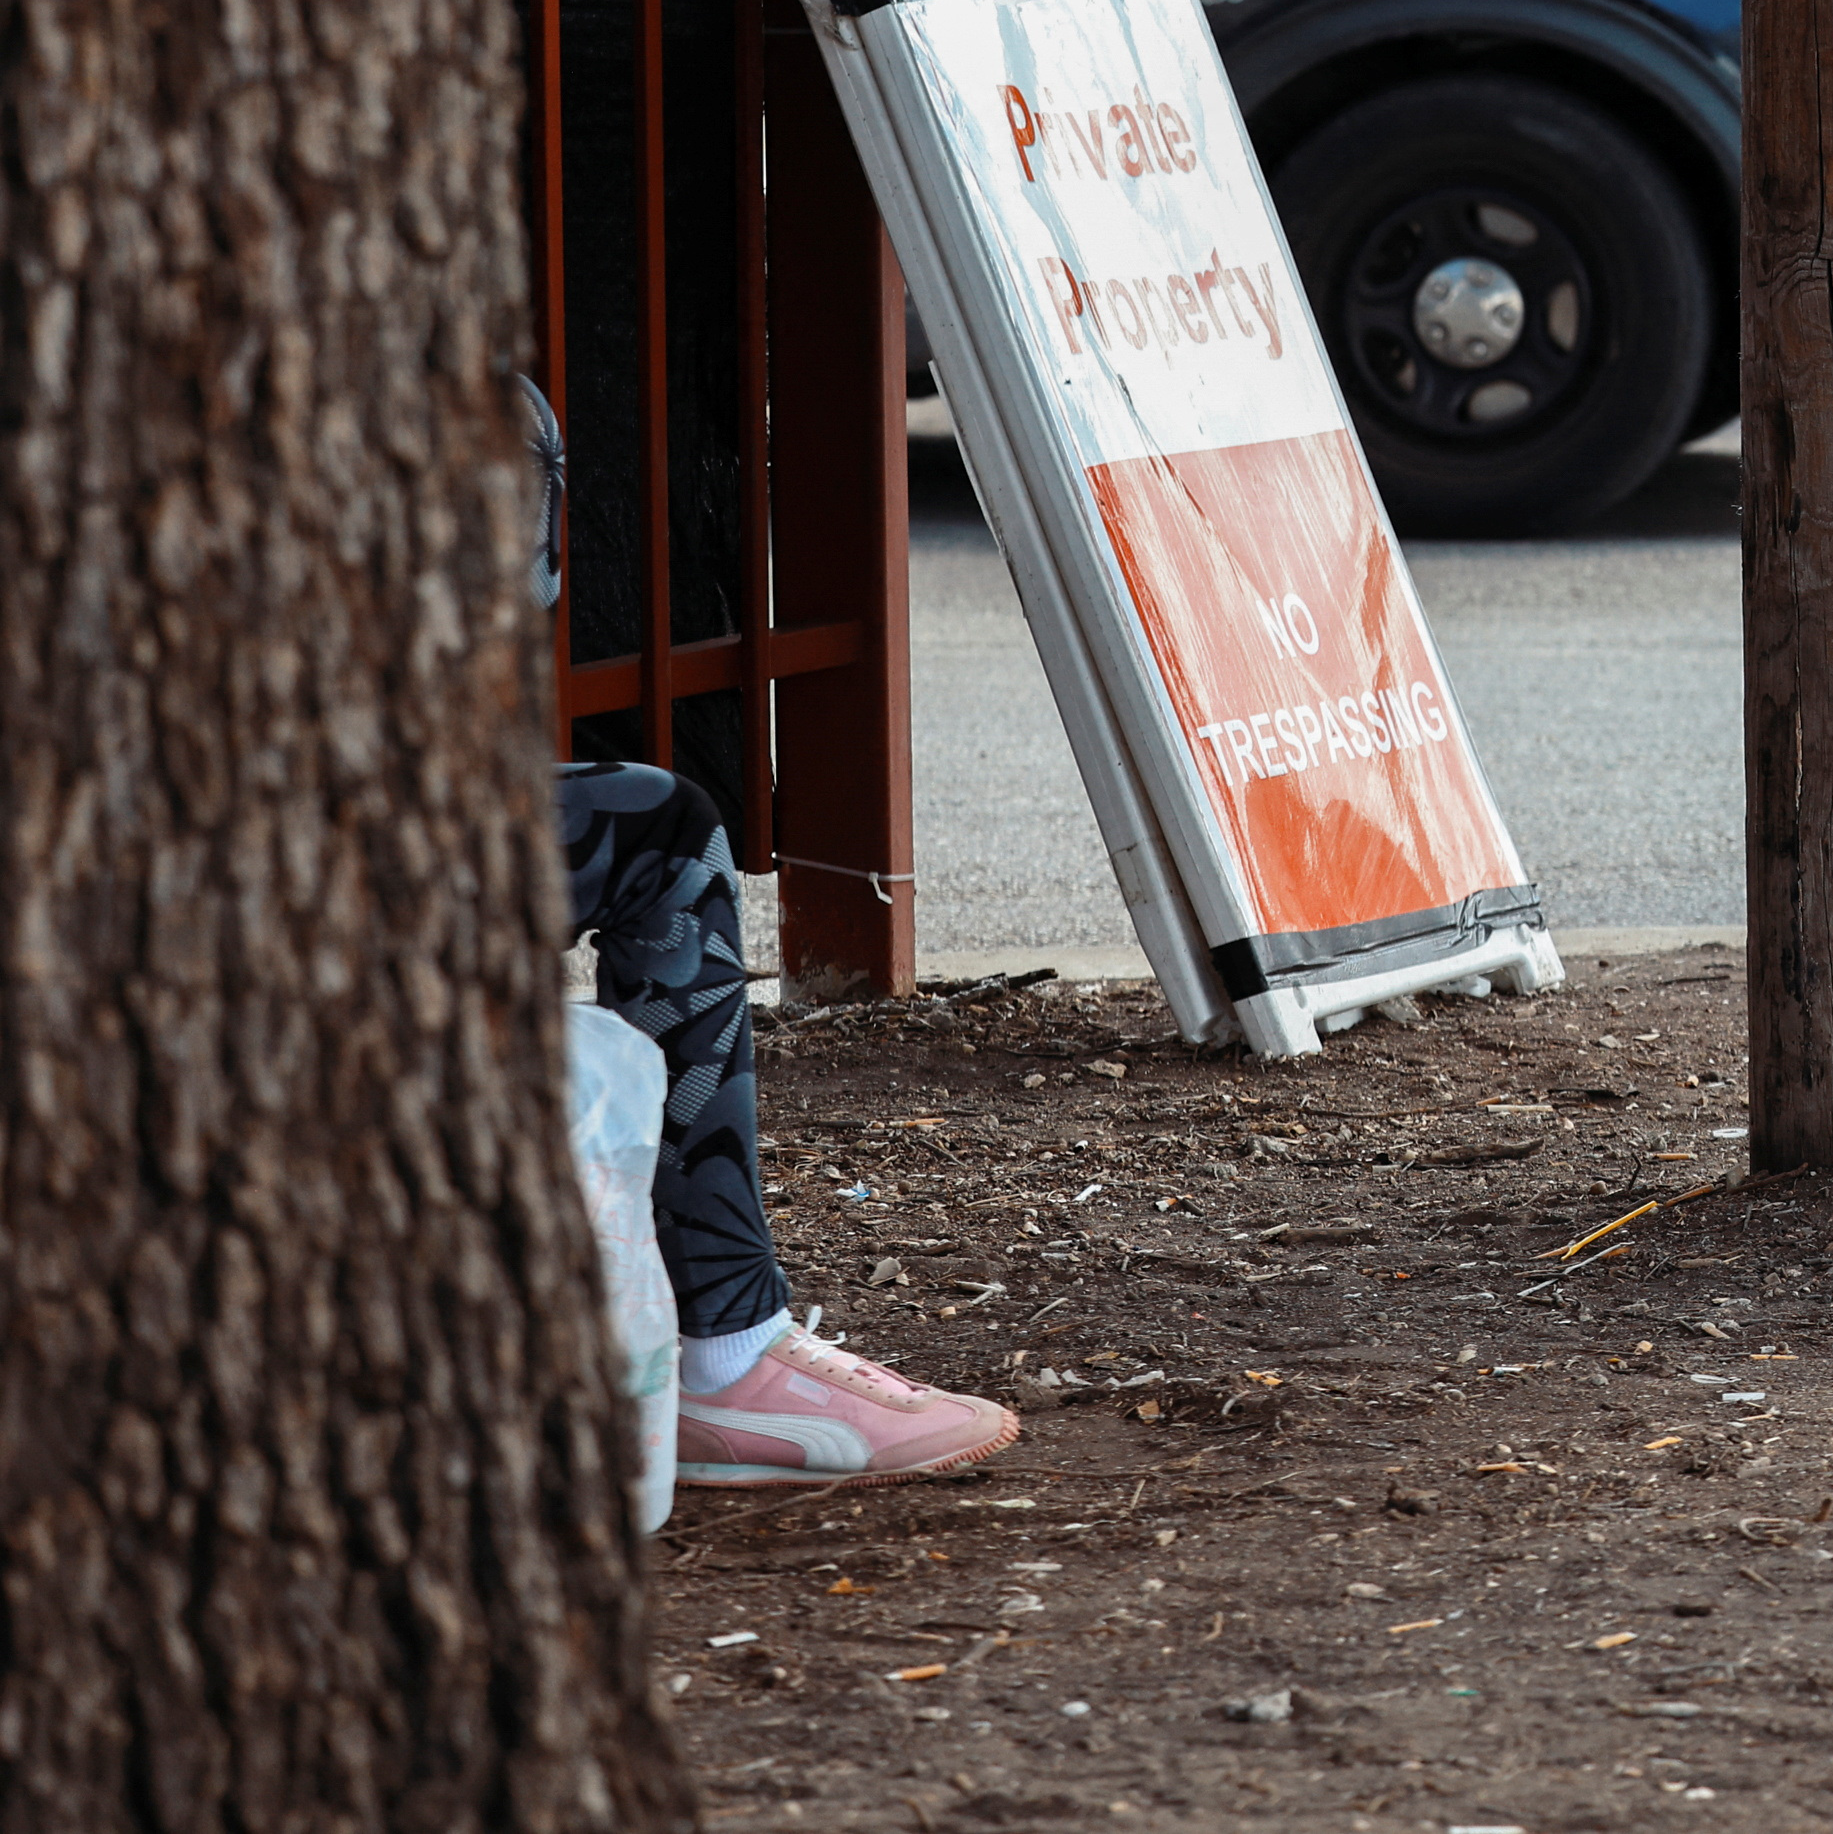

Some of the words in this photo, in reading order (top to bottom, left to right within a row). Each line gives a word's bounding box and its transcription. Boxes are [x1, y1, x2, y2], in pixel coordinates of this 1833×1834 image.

[996, 83, 1197, 182] Private
[1037, 247, 1283, 370] Property
[1256, 593, 1319, 660] NO
[1197, 681, 1448, 786] TRESPASSING
